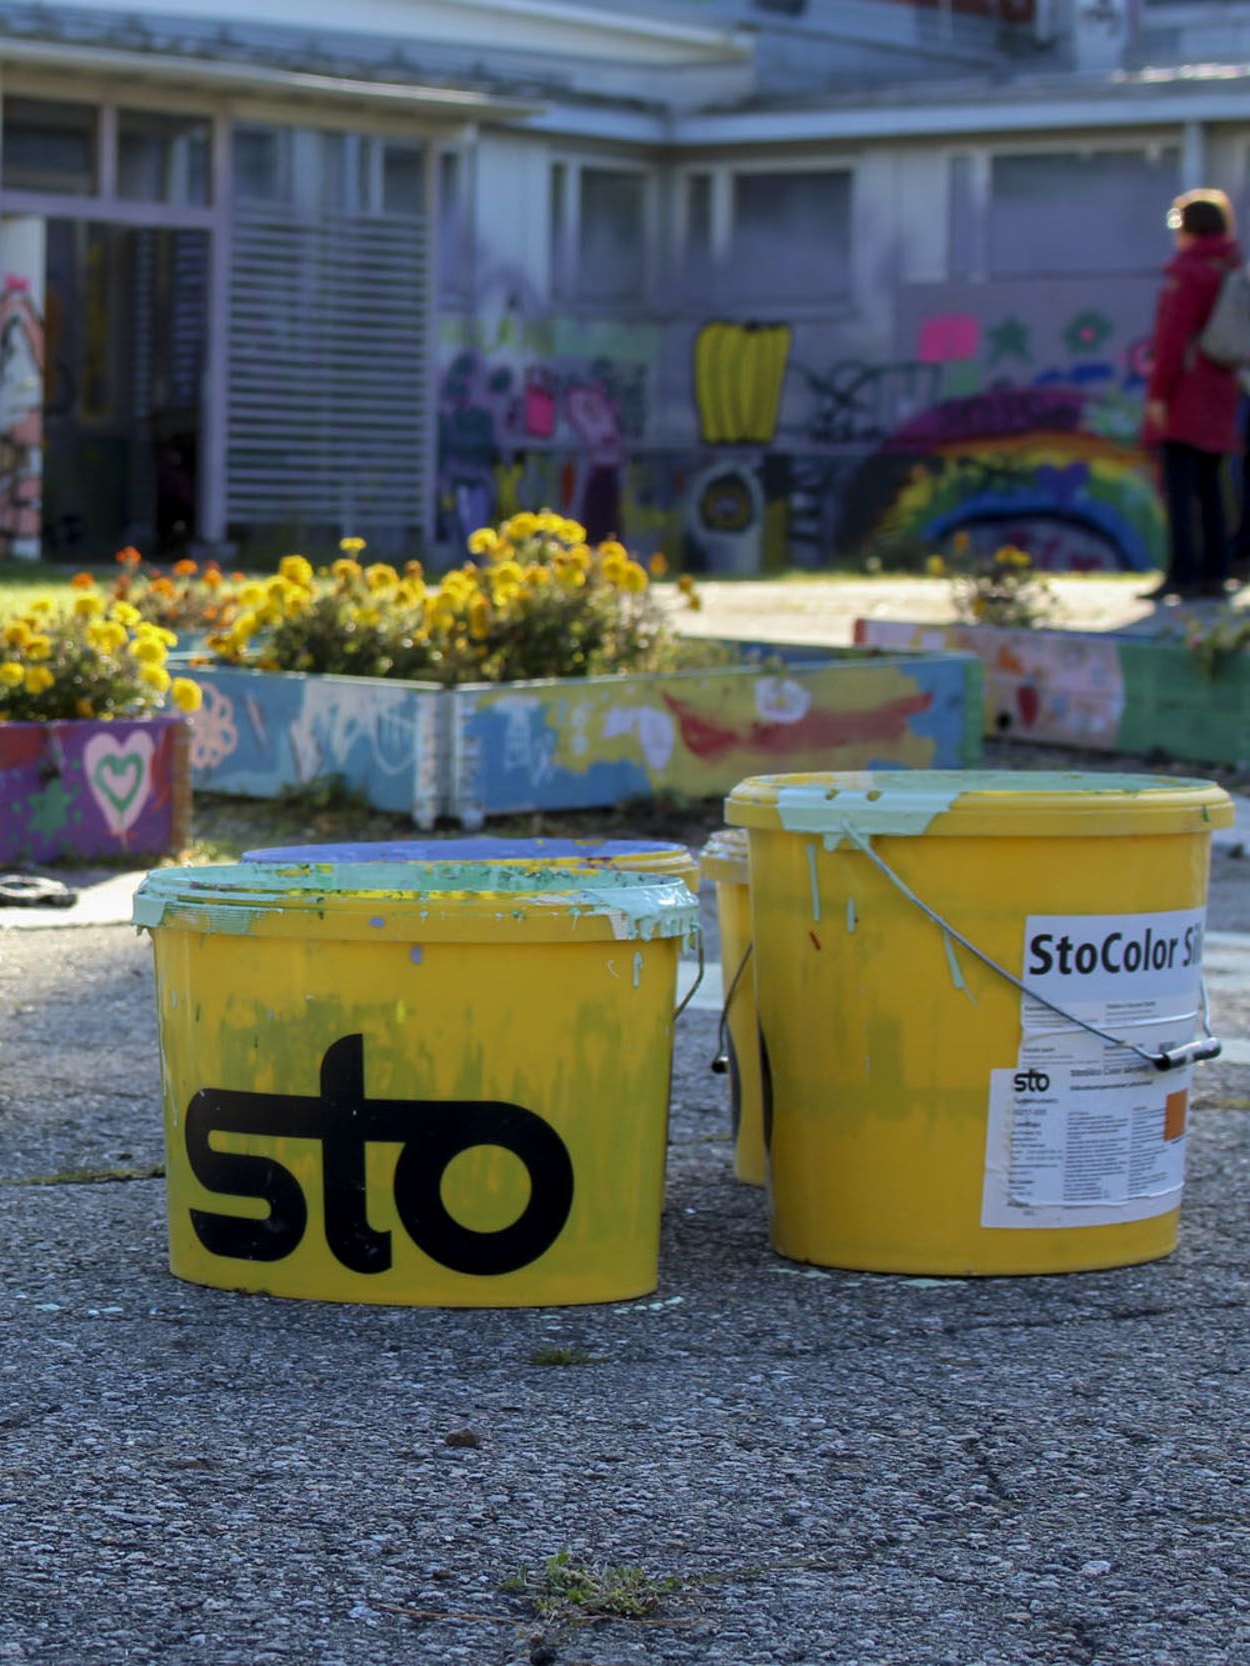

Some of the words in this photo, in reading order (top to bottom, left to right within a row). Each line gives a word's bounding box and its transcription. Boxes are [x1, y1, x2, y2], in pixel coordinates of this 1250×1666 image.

[1029, 928, 1179, 975] StoColor
[1013, 1069, 1050, 1093] sto
[185, 1033, 574, 1276] sto
